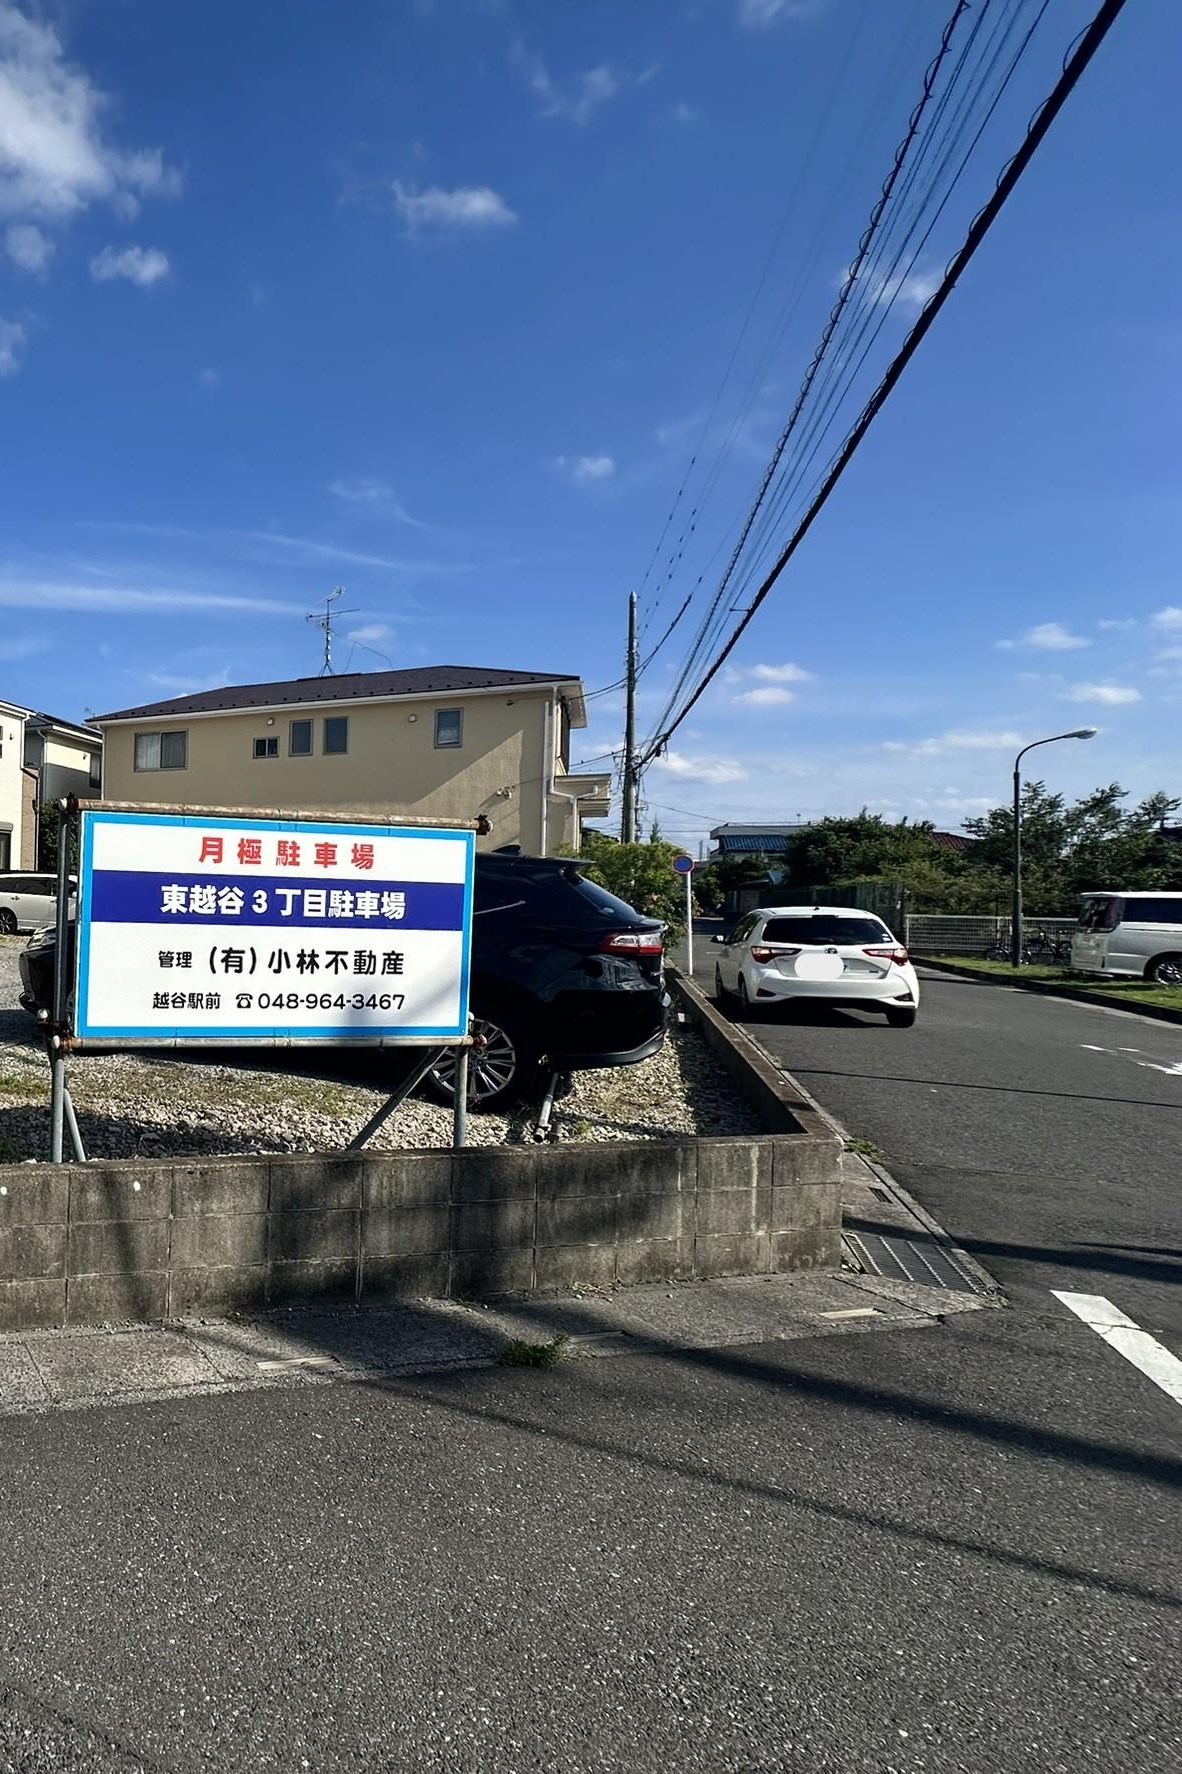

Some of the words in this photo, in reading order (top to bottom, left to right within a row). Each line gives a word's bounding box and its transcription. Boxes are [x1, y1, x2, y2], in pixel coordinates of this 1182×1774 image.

[199, 836, 374, 869] 月極駐車場
[160, 883, 406, 920] 東越谷3丁目駐車場
[158, 950, 193, 969] 管理
[209, 946, 404, 976] (有)小林不動産
[152, 991, 221, 1010] 越谷駅前
[257, 993, 405, 1010] 048-964-3467
